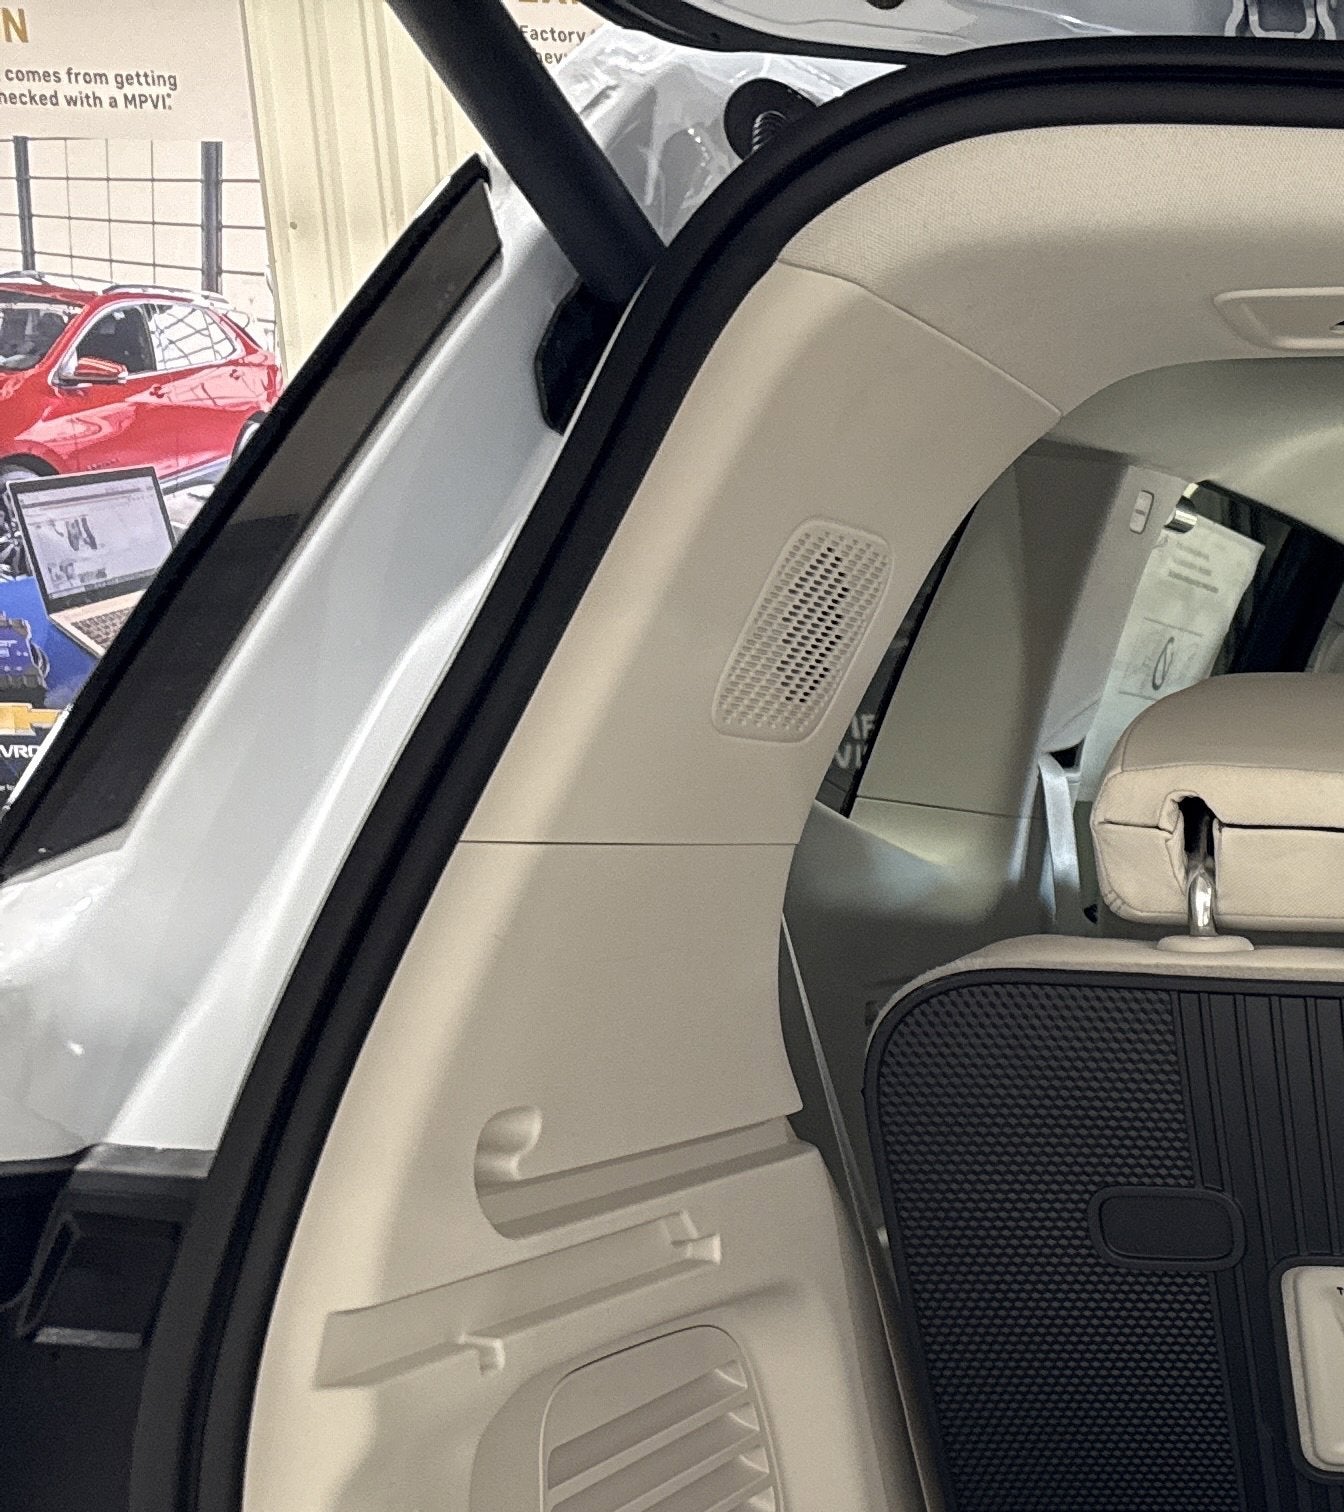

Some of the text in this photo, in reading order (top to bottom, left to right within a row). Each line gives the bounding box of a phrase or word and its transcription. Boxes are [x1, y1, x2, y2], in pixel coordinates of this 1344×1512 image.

[519, 25, 586, 44] Factory
[4, 66, 177, 91] comes from getting
[64, 91, 103, 108] with
[108, 97, 118, 109] a
